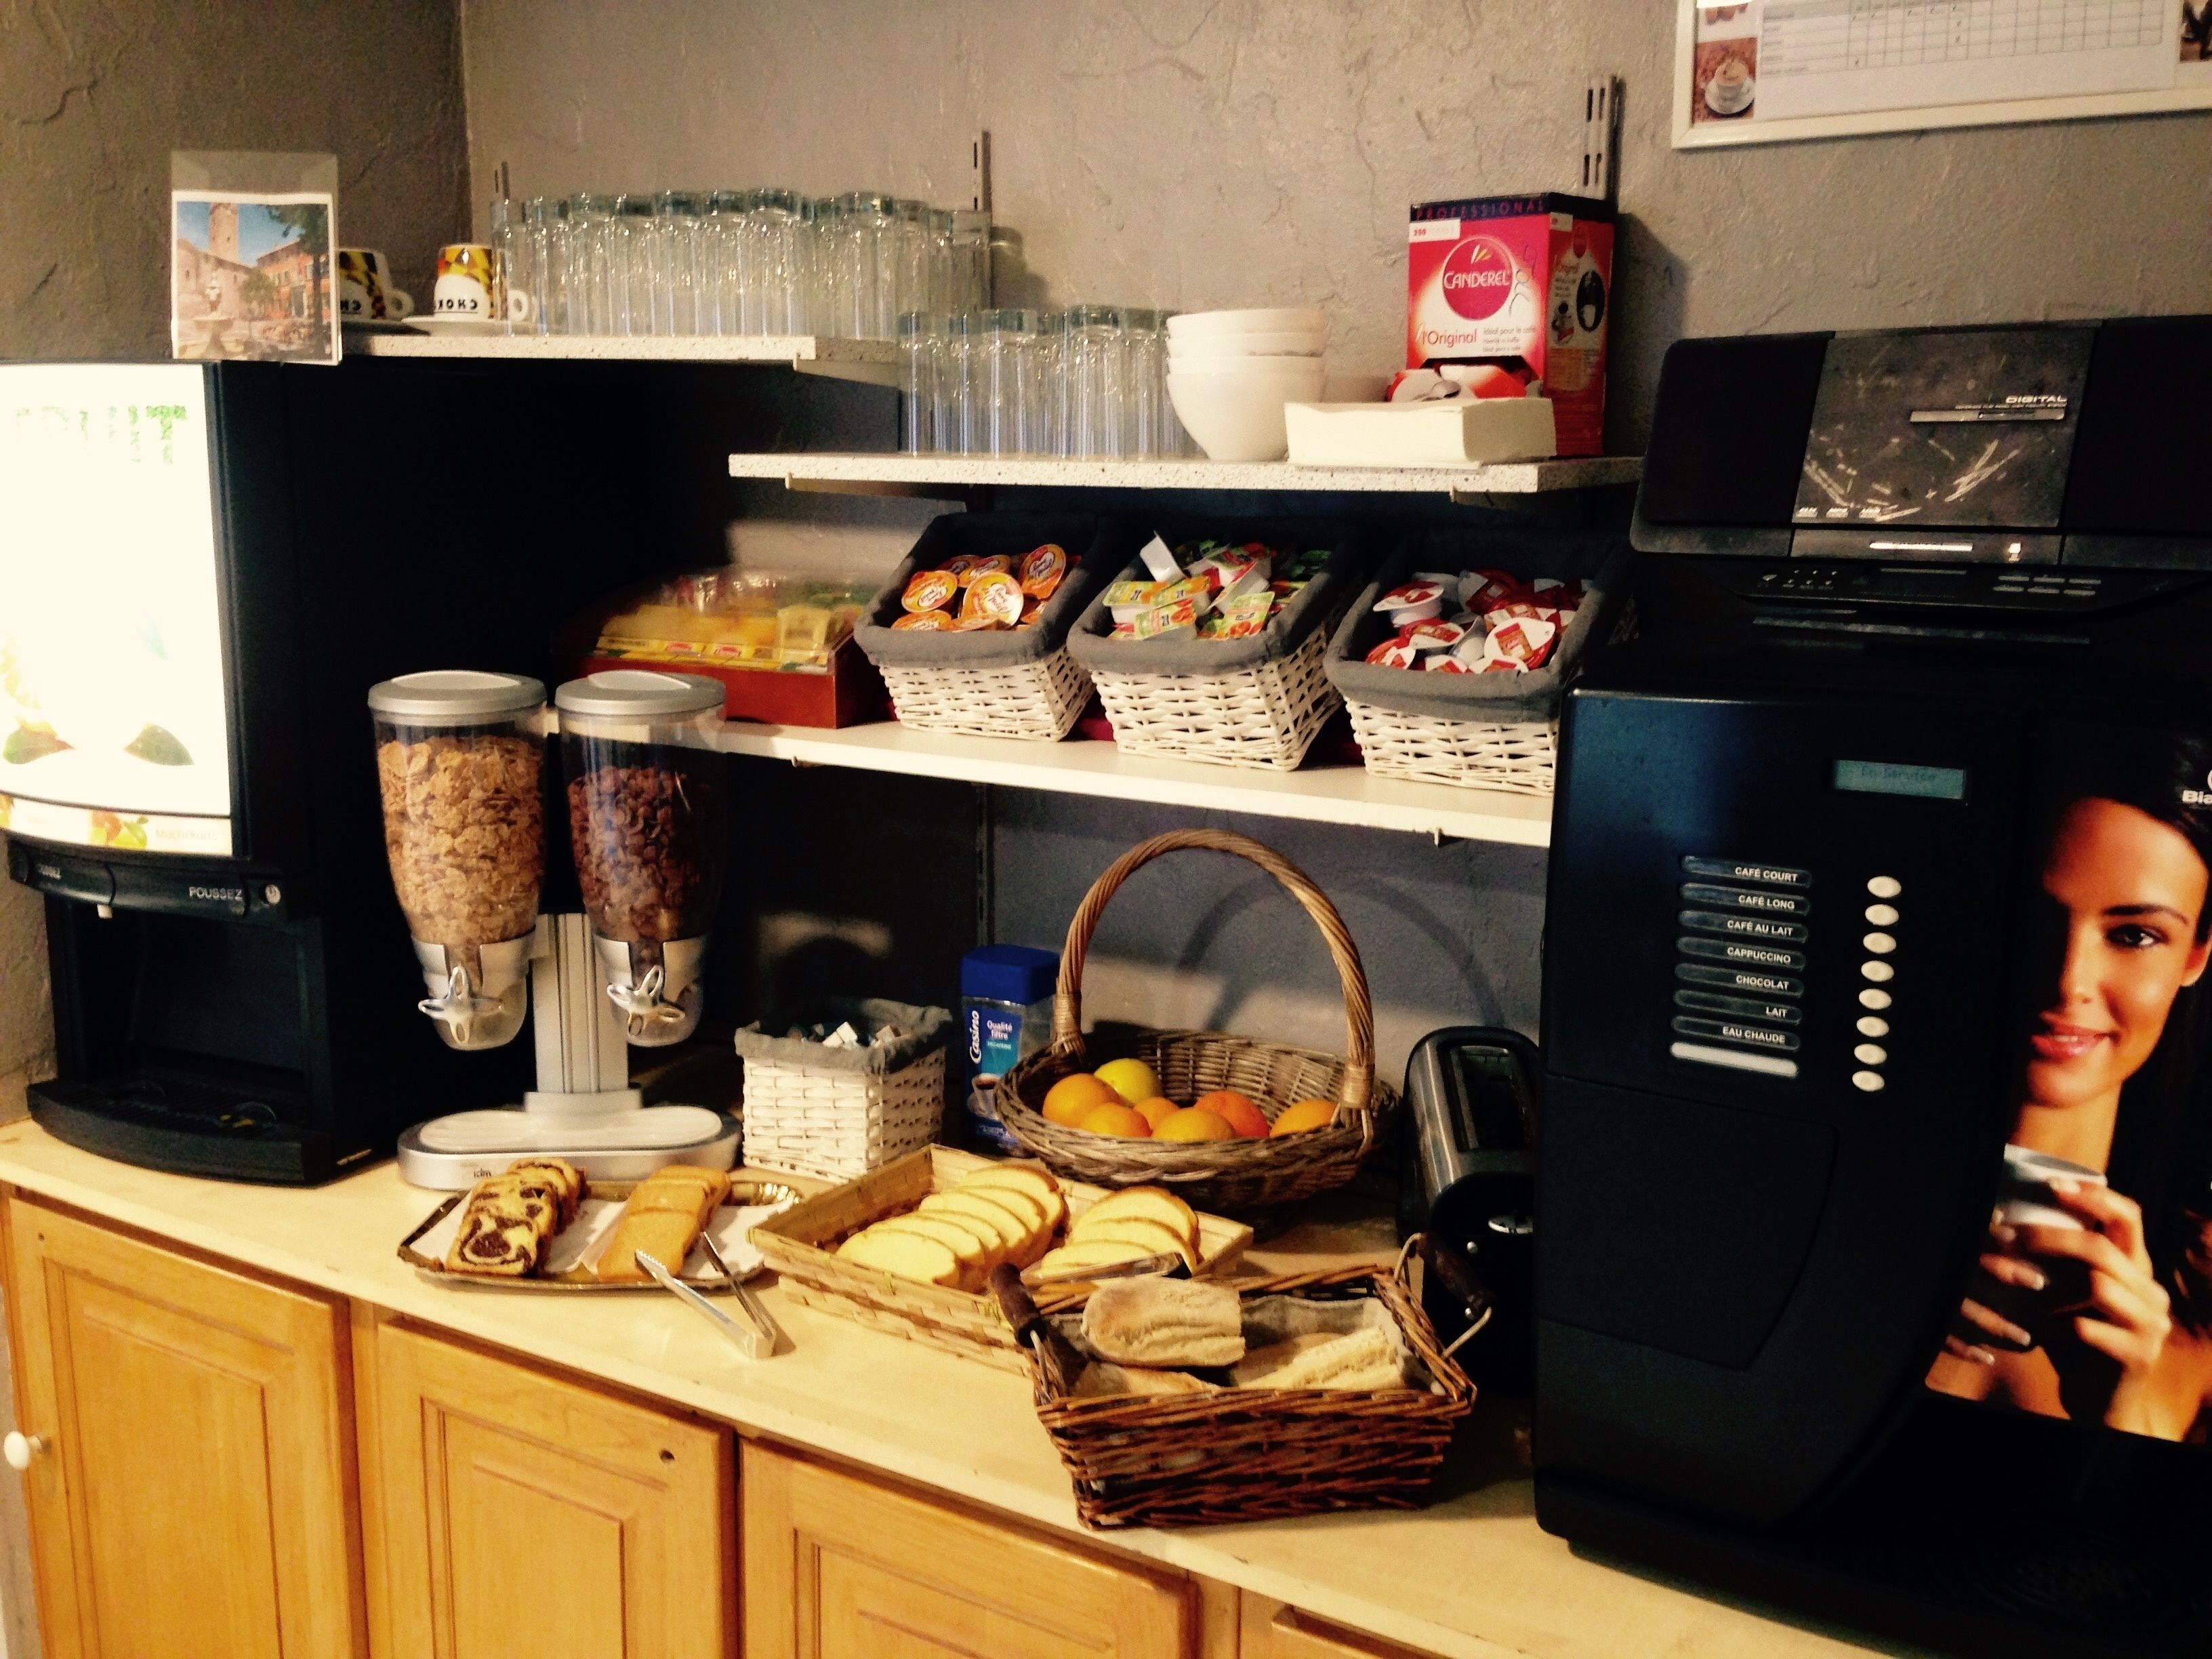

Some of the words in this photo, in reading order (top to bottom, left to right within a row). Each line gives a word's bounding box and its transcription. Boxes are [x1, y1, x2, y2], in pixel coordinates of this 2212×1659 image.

[1443, 270, 1511, 289] CANDEREL
[2005, 394, 2068, 404] DIGITAL
[1735, 867, 1761, 877] CAFÉ
[1763, 870, 1798, 882] COURT
[188, 886, 244, 901] POUSSEZ
[1738, 895, 1764, 905] CAFÉ
[1767, 898, 1795, 909] LONG
[1727, 920, 1753, 930] CAFÉ
[1755, 923, 1769, 933] AU
[1771, 925, 1793, 936] LAIT
[1727, 947, 1791, 964] CAPPUCCINO
[1736, 975, 1789, 991] CHOCOLAT
[1765, 1006, 1788, 1018] LAIT
[987, 1020, 1012, 1033] Qualité
[969, 1010, 982, 1064] Casino
[1722, 1026, 1742, 1037] EAU
[1744, 1029, 1786, 1043] CHAUDE
